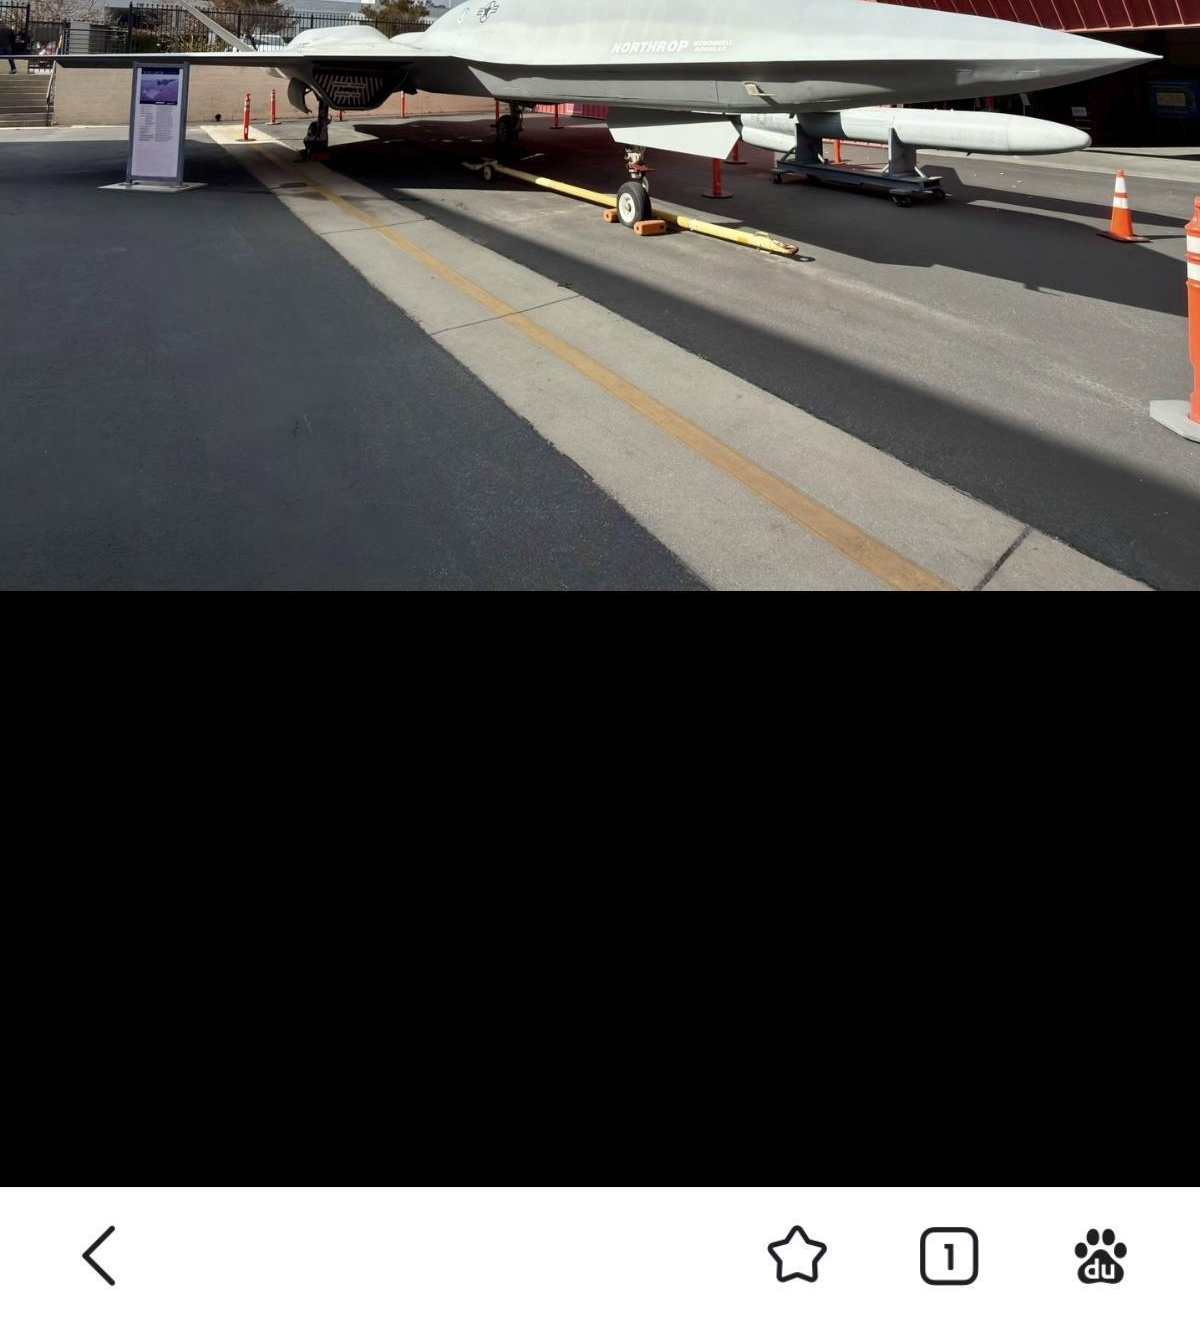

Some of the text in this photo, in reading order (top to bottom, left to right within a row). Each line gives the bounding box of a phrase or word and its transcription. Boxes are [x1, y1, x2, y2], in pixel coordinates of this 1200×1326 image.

[612, 40, 689, 54] NORTHROP
[943, 1242, 955, 1271] 1
[1084, 1257, 1115, 1280] du
